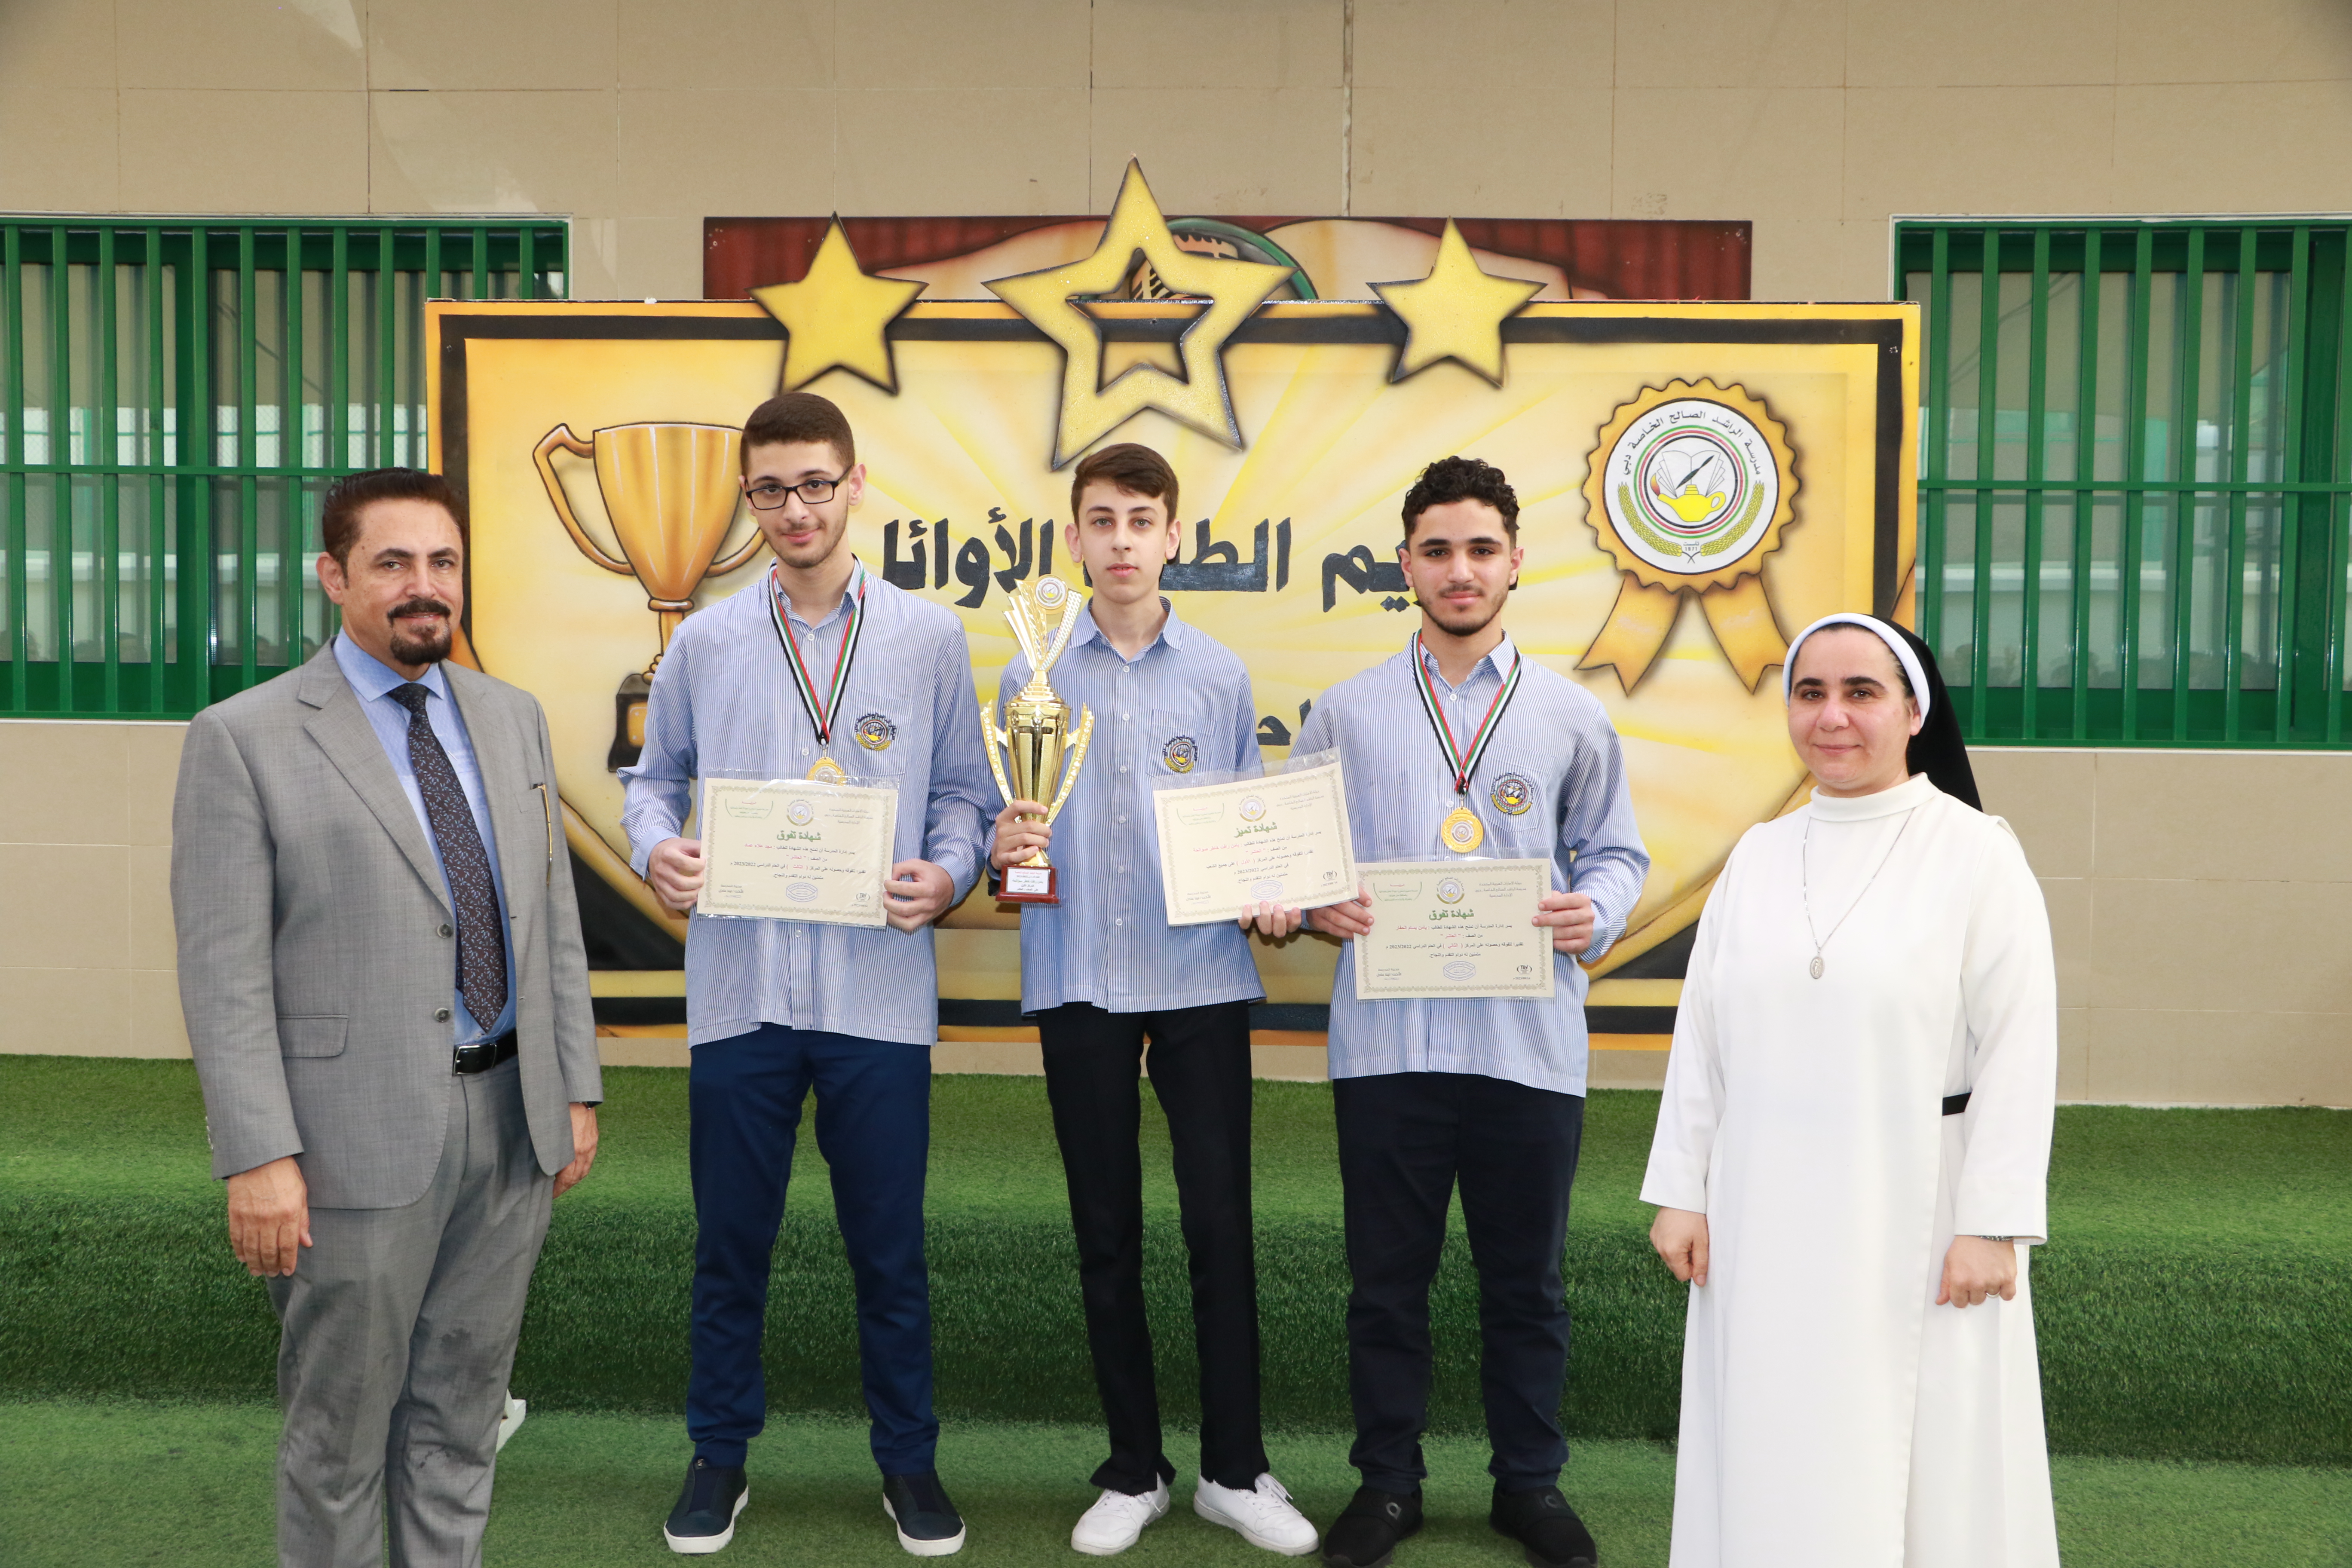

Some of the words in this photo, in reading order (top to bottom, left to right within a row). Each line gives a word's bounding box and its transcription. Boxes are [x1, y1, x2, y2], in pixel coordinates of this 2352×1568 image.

[1669, 410, 1706, 424] الصالح
[1712, 416, 1744, 438] الراشد
[1627, 417, 1663, 450] الخاصة
[1744, 438, 1761, 475] مدرسة
[1623, 454, 1631, 475] دبي
[1234, 826, 1252, 838] تميز
[1254, 821, 1277, 833] شهادة
[777, 830, 796, 841] تفوق
[799, 831, 821, 842] شهادة
[1429, 909, 1449, 921] تفوق
[1451, 908, 1474, 919] شهادة
